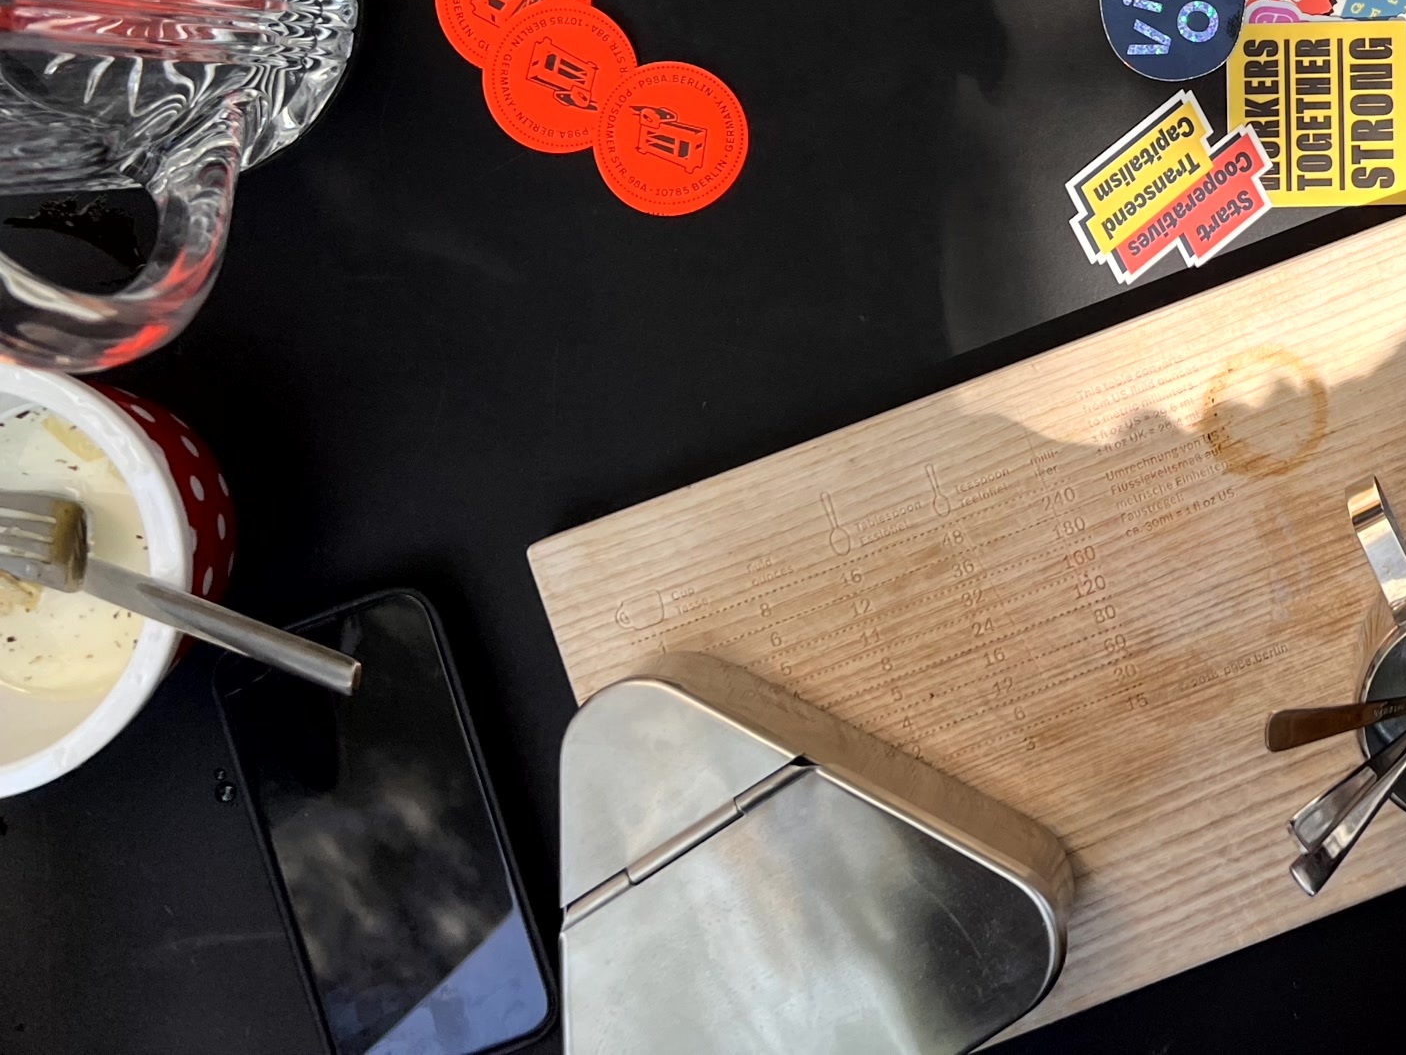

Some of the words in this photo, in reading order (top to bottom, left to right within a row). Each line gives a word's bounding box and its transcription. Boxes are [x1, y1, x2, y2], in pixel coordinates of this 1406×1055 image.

[511, 19, 546, 47] BERLIN
[550, 16, 582, 26] 10785
[590, 24, 610, 42] 98A
[500, 53, 514, 106] GERMANY
[1295, 38, 1332, 191] TOGETHER
[1349, 37, 1394, 189] STRONG
[606, 89, 632, 153] POTSDAMER
[628, 176, 647, 192] 98A
[655, 186, 690, 196] 10785
[692, 159, 727, 191] BERLIN
[714, 100, 735, 152] GERMANY
[1093, 116, 1194, 201] Capitalism
[1101, 153, 1201, 240] Transcend
[1128, 152, 1252, 255] Cooperatives
[1196, 190, 1254, 242] Start
[953, 466, 1010, 495] Teaspoon
[1104, 447, 1179, 481] Umrechnung
[1180, 438, 1200, 453] von
[1115, 480, 1173, 509] metrische
[853, 498, 922, 533] Tablespoon
[758, 601, 773, 618] 8
[838, 568, 863, 587] 16
[940, 529, 965, 548] 48
[1040, 486, 1076, 511] 240
[768, 630, 783, 647] 6
[848, 596, 873, 617] 12
[951, 559, 975, 579] 36
[1052, 515, 1086, 539] 180
[670, 586, 695, 600] Cup
[778, 660, 793, 676] 5
[857, 627, 881, 647] 11
[959, 587, 986, 609] 32
[1060, 544, 1097, 571] 160
[878, 655, 894, 672] 8
[970, 616, 995, 638] 24
[1071, 573, 1107, 599] 120
[889, 685, 904, 702] 5
[980, 646, 1006, 668] 16
[1091, 603, 1118, 625] 80
[900, 714, 914, 729] 4
[990, 676, 1015, 698] 12
[1102, 632, 1128, 654] 60
[1012, 704, 1026, 721] 6
[1111, 662, 1138, 684] 30
[1124, 692, 1149, 712] 15
